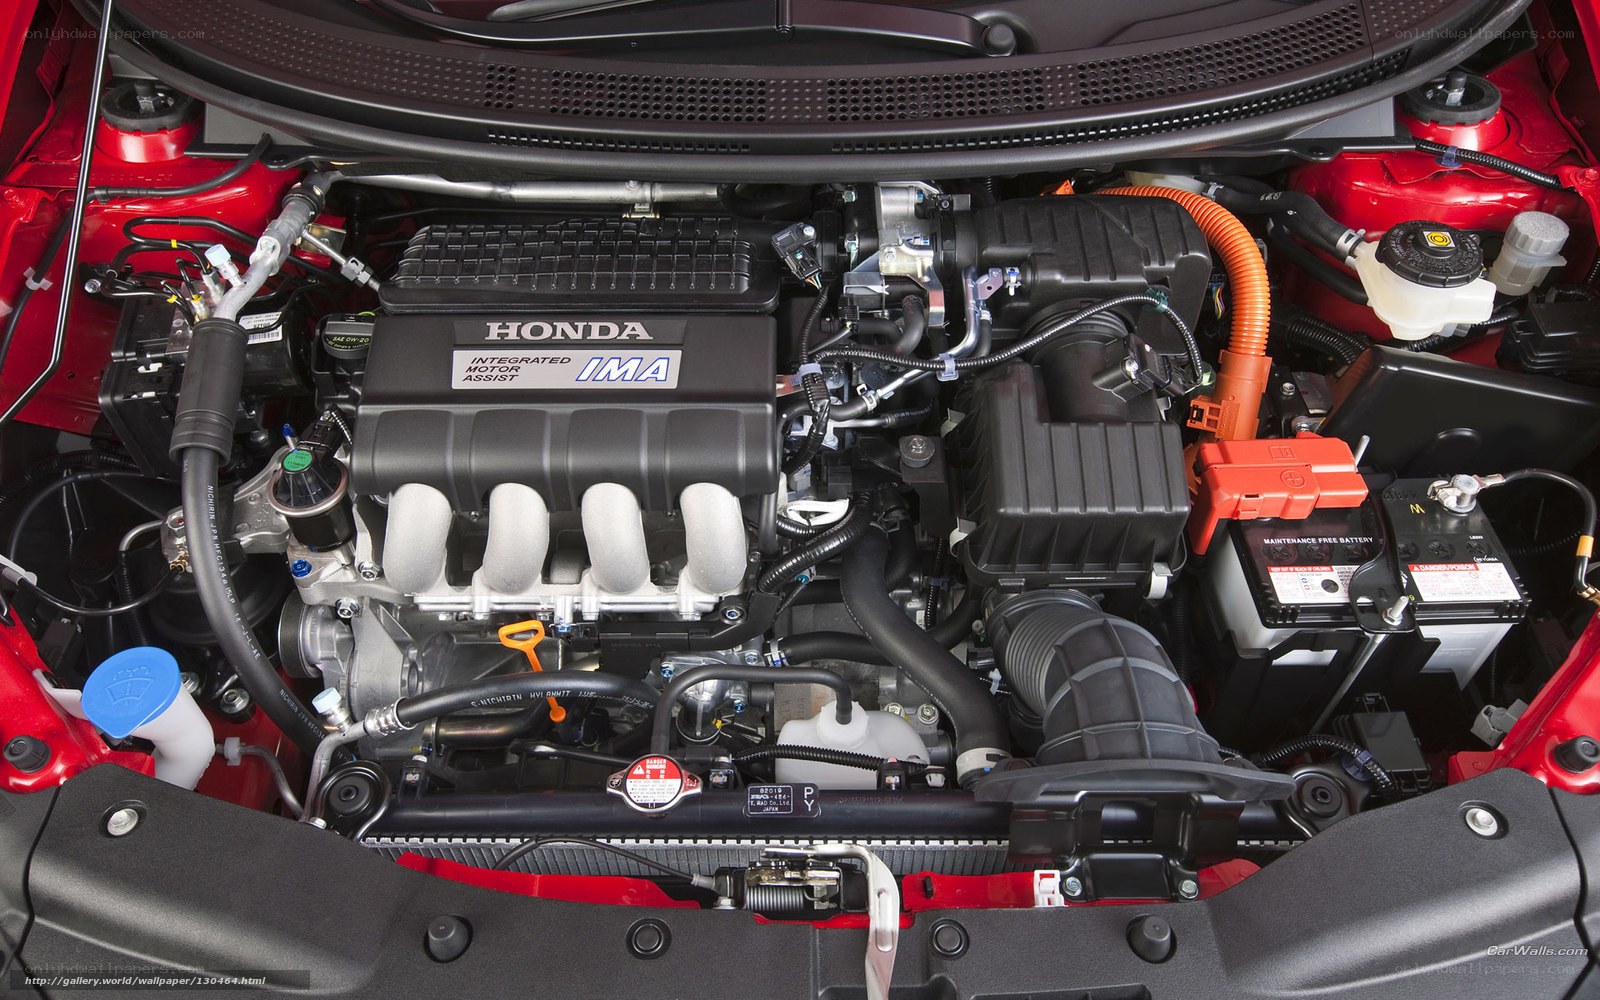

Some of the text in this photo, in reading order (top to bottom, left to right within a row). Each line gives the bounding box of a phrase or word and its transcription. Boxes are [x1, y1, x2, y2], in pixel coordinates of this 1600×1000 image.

[484, 321, 653, 341] HONDA
[465, 365, 521, 373] MOTOR
[575, 357, 670, 382] IMA
[462, 374, 518, 382] ASSIST
[207, 485, 216, 520] NICHIRIN
[210, 523, 219, 540] JPN
[279, 689, 299, 713] NICHIRIN
[470, 693, 523, 708] S-NICHIRIN
[804, 786, 814, 799] P
[803, 799, 815, 812] Y
